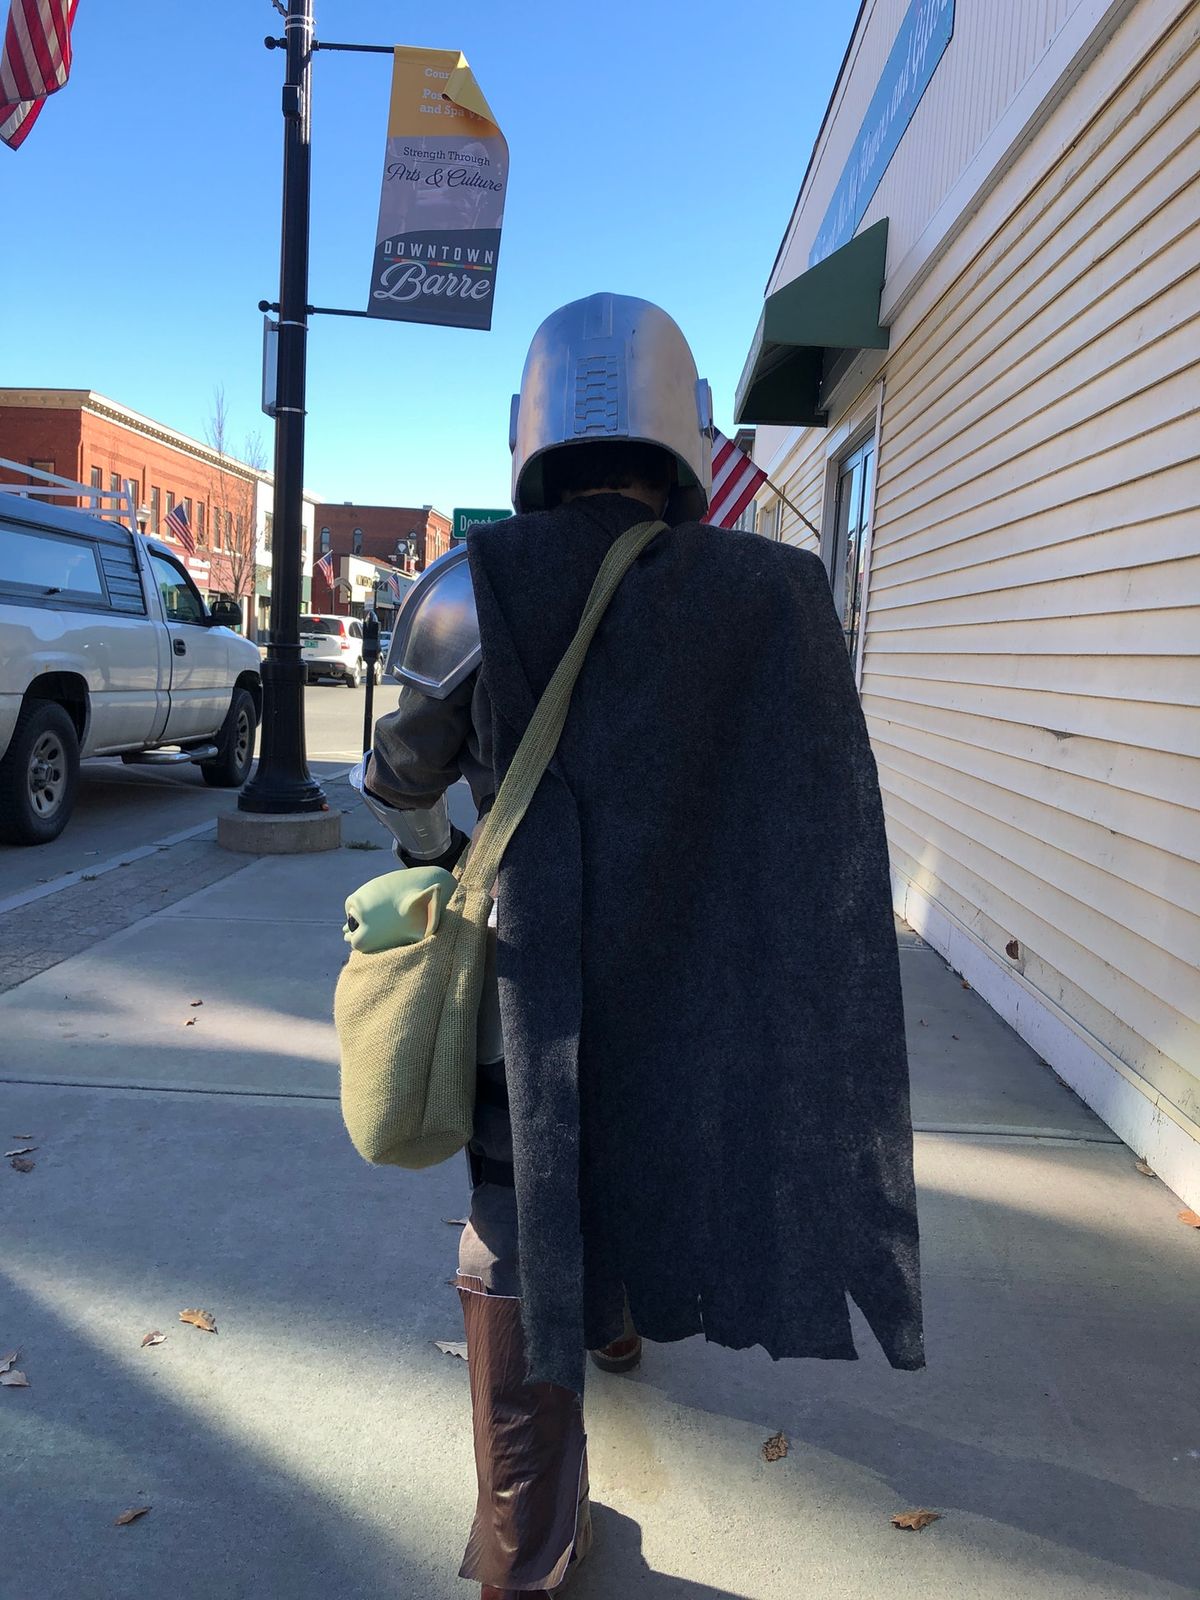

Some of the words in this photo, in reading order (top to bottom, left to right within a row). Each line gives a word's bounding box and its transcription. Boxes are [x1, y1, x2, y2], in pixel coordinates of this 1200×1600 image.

[424, 68, 450, 79] Cour
[423, 89, 443, 100] Pos
[419, 104, 441, 114] and
[403, 147, 446, 160] Strength
[448, 151, 490, 166] Through
[387, 162, 421, 181] Arts
[425, 168, 443, 188] &
[447, 169, 503, 191] Culture
[384, 241, 494, 264] DOWNTOWN
[373, 262, 491, 301] Barre
